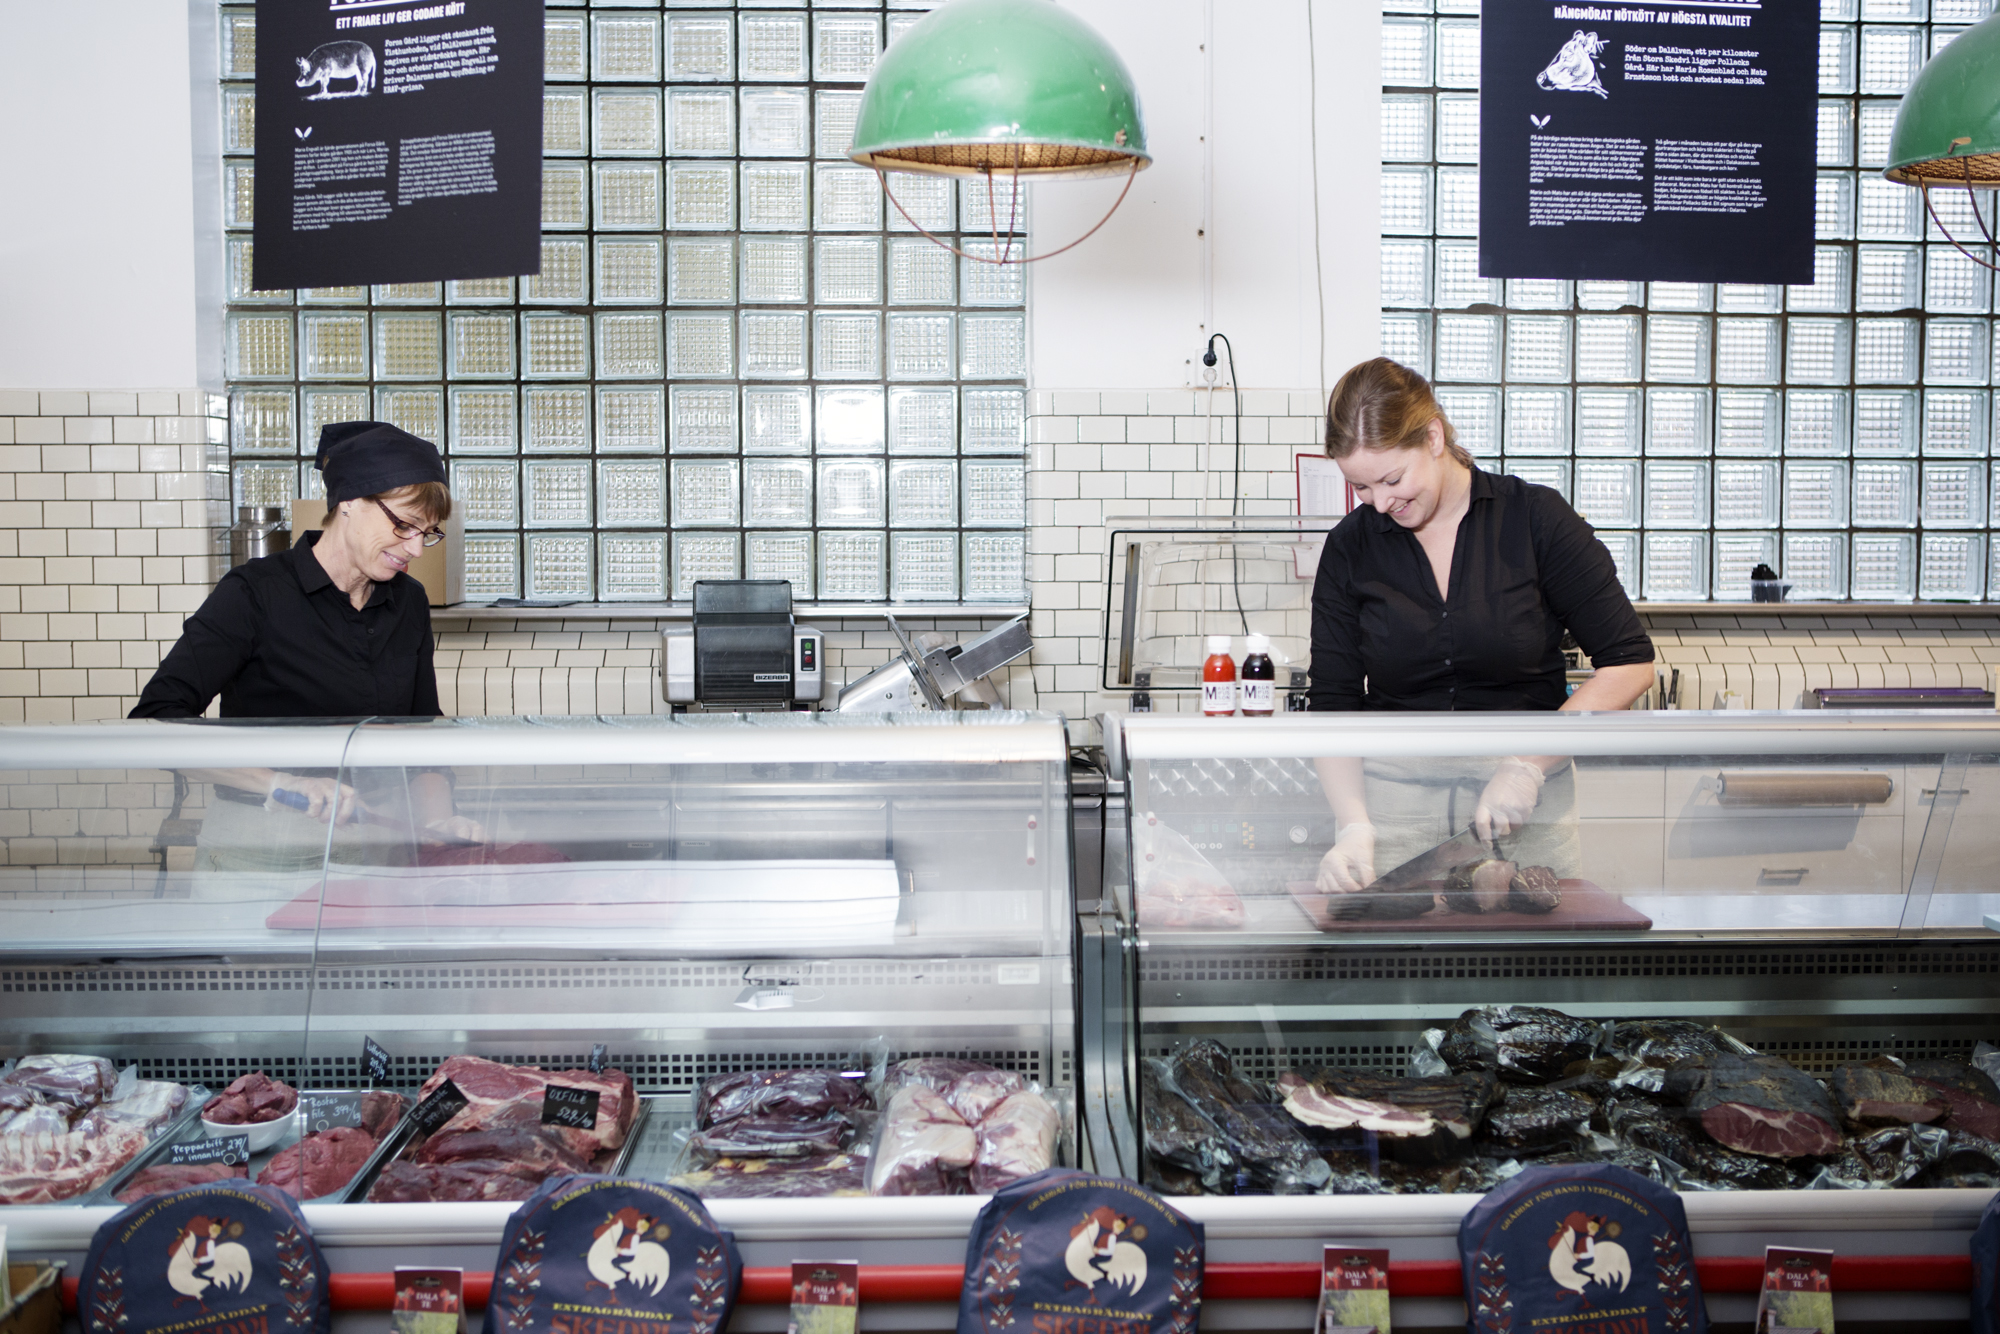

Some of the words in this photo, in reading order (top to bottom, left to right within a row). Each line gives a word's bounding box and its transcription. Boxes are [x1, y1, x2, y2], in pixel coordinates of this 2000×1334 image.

[336, 17, 351, 29] ETT
[352, 14, 381, 27] FRIARE
[382, 12, 396, 24] LIV
[396, 10, 412, 22] GER
[413, 6, 444, 20] GODARE
[445, 3, 465, 16] KÖTT
[1554, 7, 1613, 20] HÄNGMÖRAT
[1614, 9, 1656, 22] NÖTKÖTT
[1657, 12, 1670, 23] AV
[1672, 12, 1707, 24] HÖGSTA
[1709, 15, 1751, 26] KVALITET
[1692, 57, 1717, 67] ligger
[1624, 73, 1662, 81] Ernstsson
[1698, 66, 1735, 74] Rosenblad
[1206, 687, 1216, 699] M
[1245, 685, 1256, 699] M
[309, 1096, 338, 1108] Rostas
[157, 1195, 176, 1211] FÖR
[177, 1189, 202, 1202] HAND
[257, 1200, 274, 1214] UGN
[1536, 1190, 1553, 1202] FÖR
[1555, 1185, 1579, 1195] HAND
[1633, 1202, 1649, 1216] UGN
[416, 1292, 438, 1301] DALA
[813, 1286, 835, 1295] DALA
[552, 1303, 674, 1321] EXTRAGRÄDDAT
[1033, 1302, 1153, 1321] EXTRAGRÄDDAT
[1531, 1306, 1647, 1326] EXTRAGRÄDDAT
